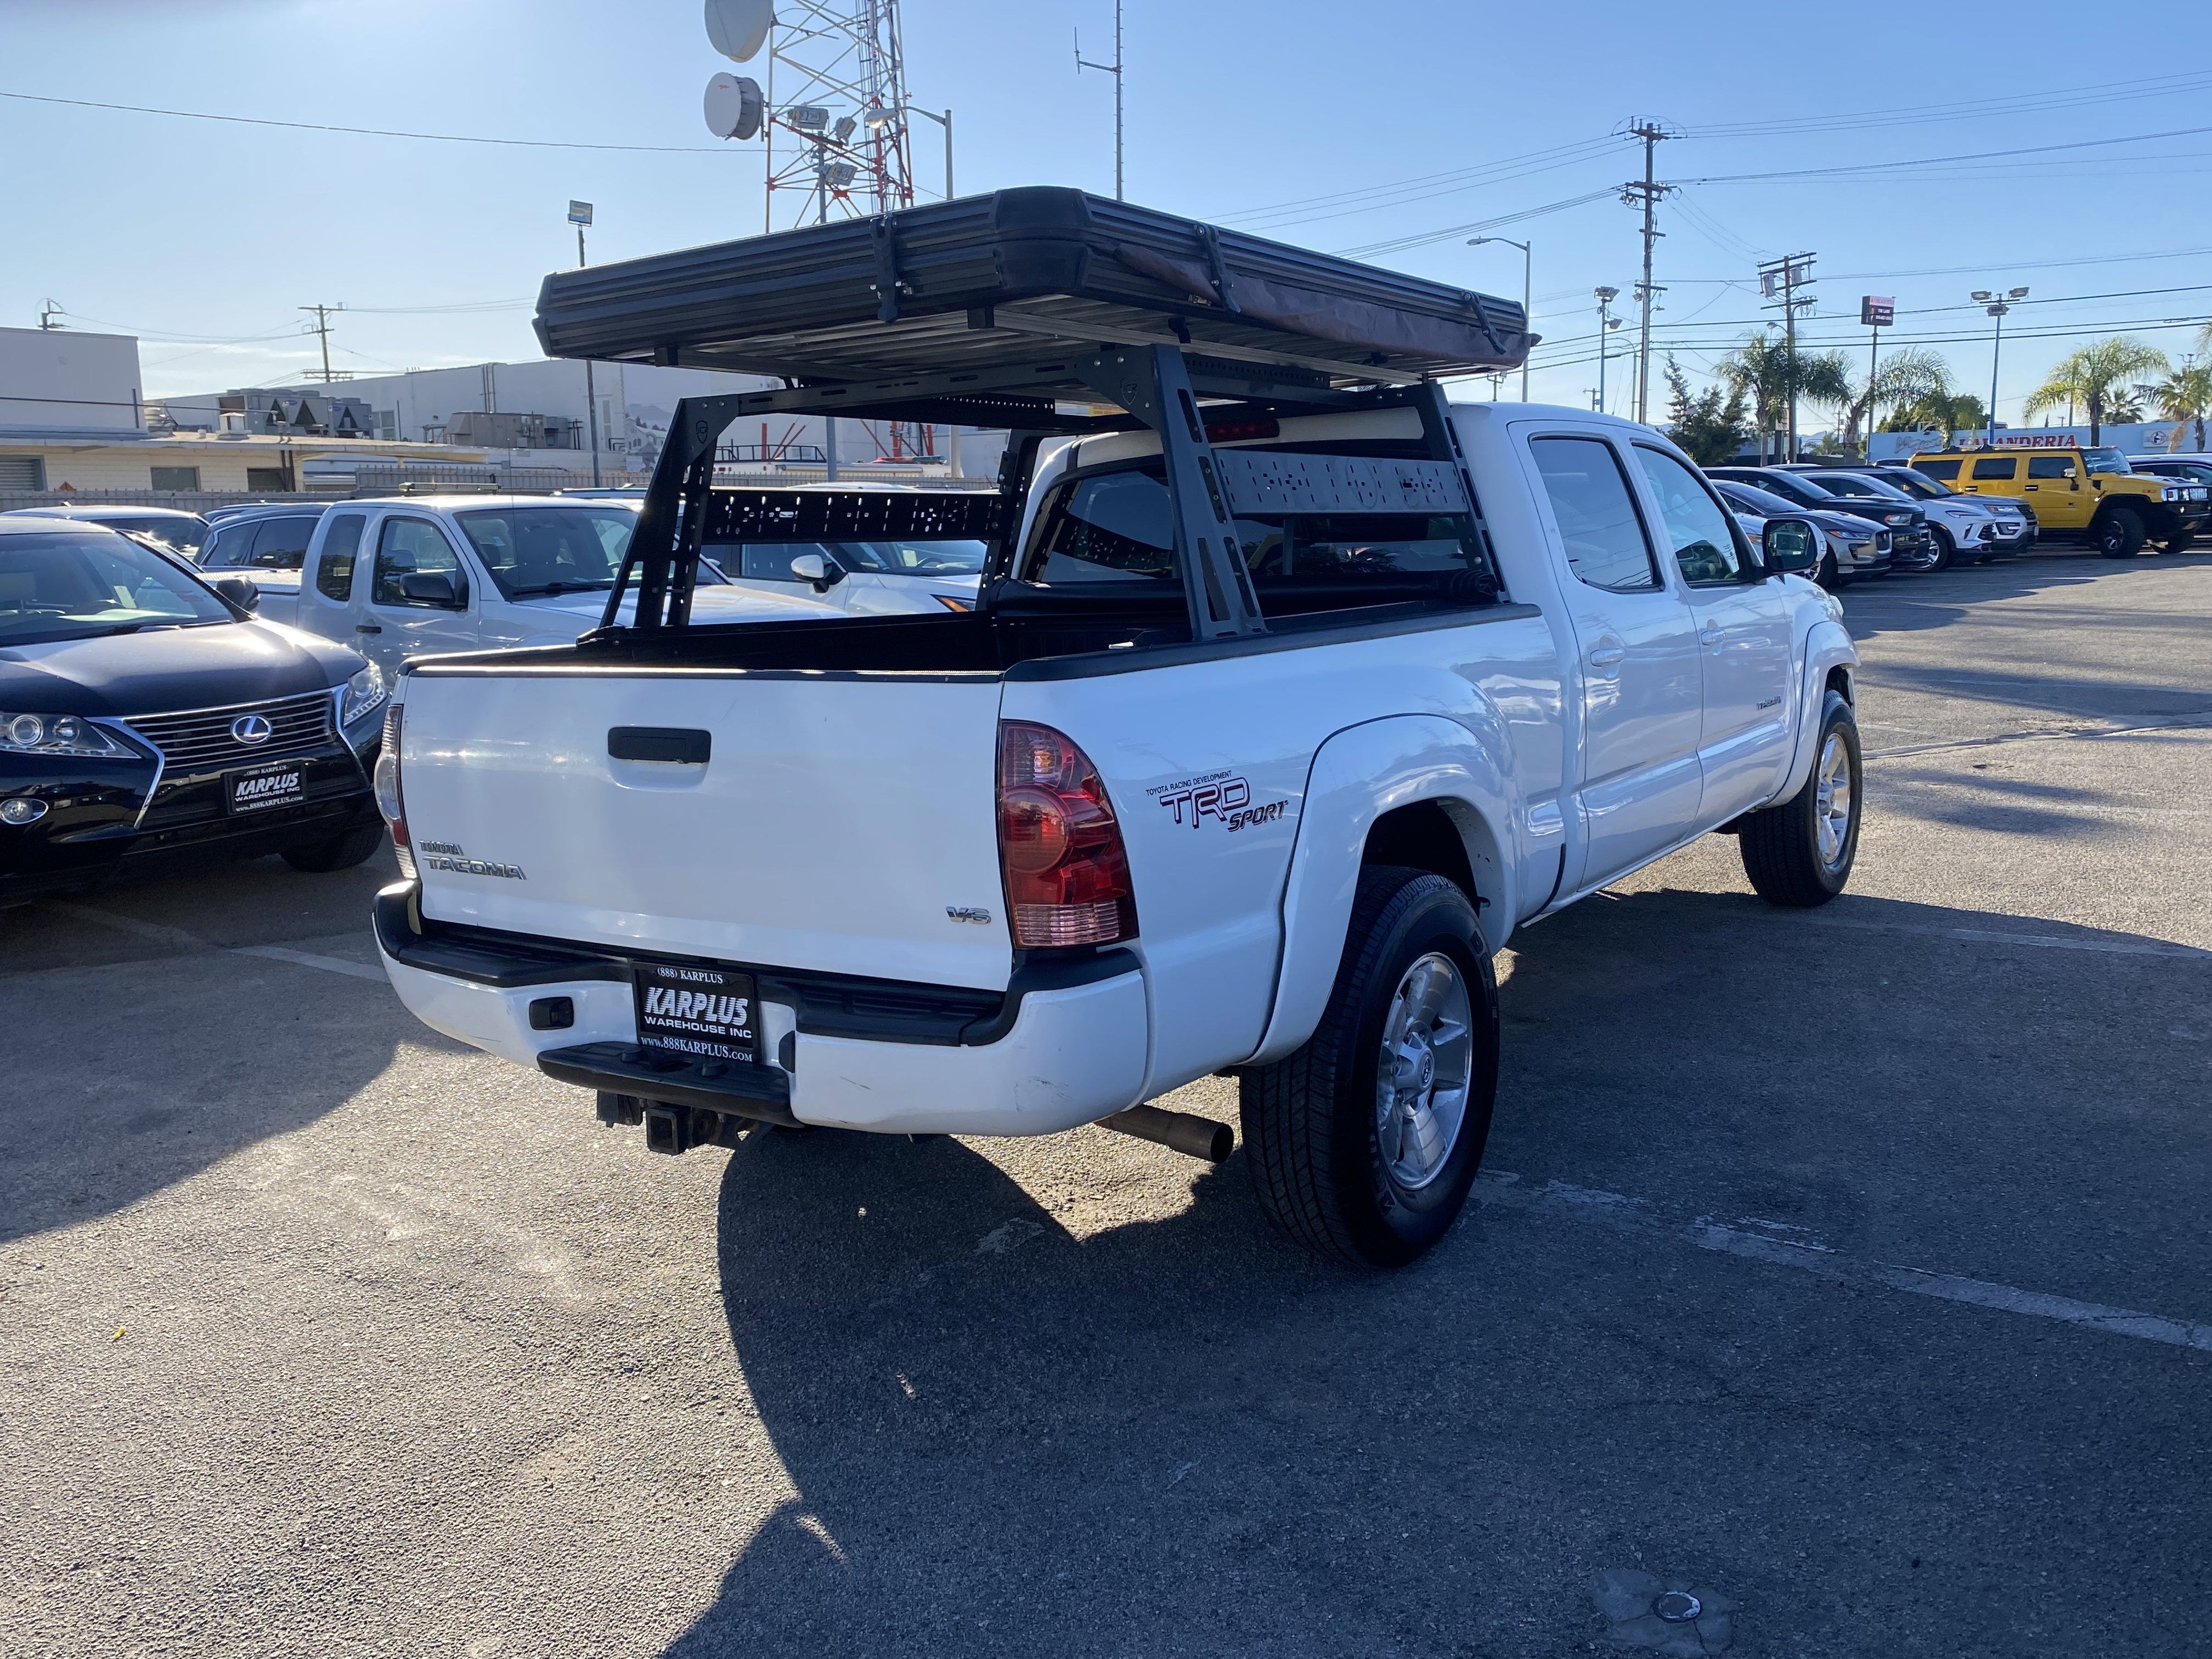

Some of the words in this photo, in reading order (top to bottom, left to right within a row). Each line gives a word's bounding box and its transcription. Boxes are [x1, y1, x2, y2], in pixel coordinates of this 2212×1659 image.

[261, 765, 286, 774] KARPLUS
[236, 772, 299, 796] KARPLUS
[1146, 784, 1169, 796] TOYOTA
[1170, 780, 1192, 790] RACING
[1193, 770, 1232, 785] DEVELOPMENT
[235, 789, 285, 802] WAREHOUSE
[1159, 777, 1250, 829] TRD
[1227, 800, 1289, 832] SPORT
[418, 839, 464, 856] TOYOTA
[422, 855, 527, 880] TACOMA
[945, 906, 991, 924] V6
[657, 967, 678, 978] (888)
[680, 970, 723, 984] KARPLUS
[644, 987, 748, 1026] KARPLUS
[644, 1016, 725, 1035] WAREHOUSE
[730, 1028, 752, 1039] INC
